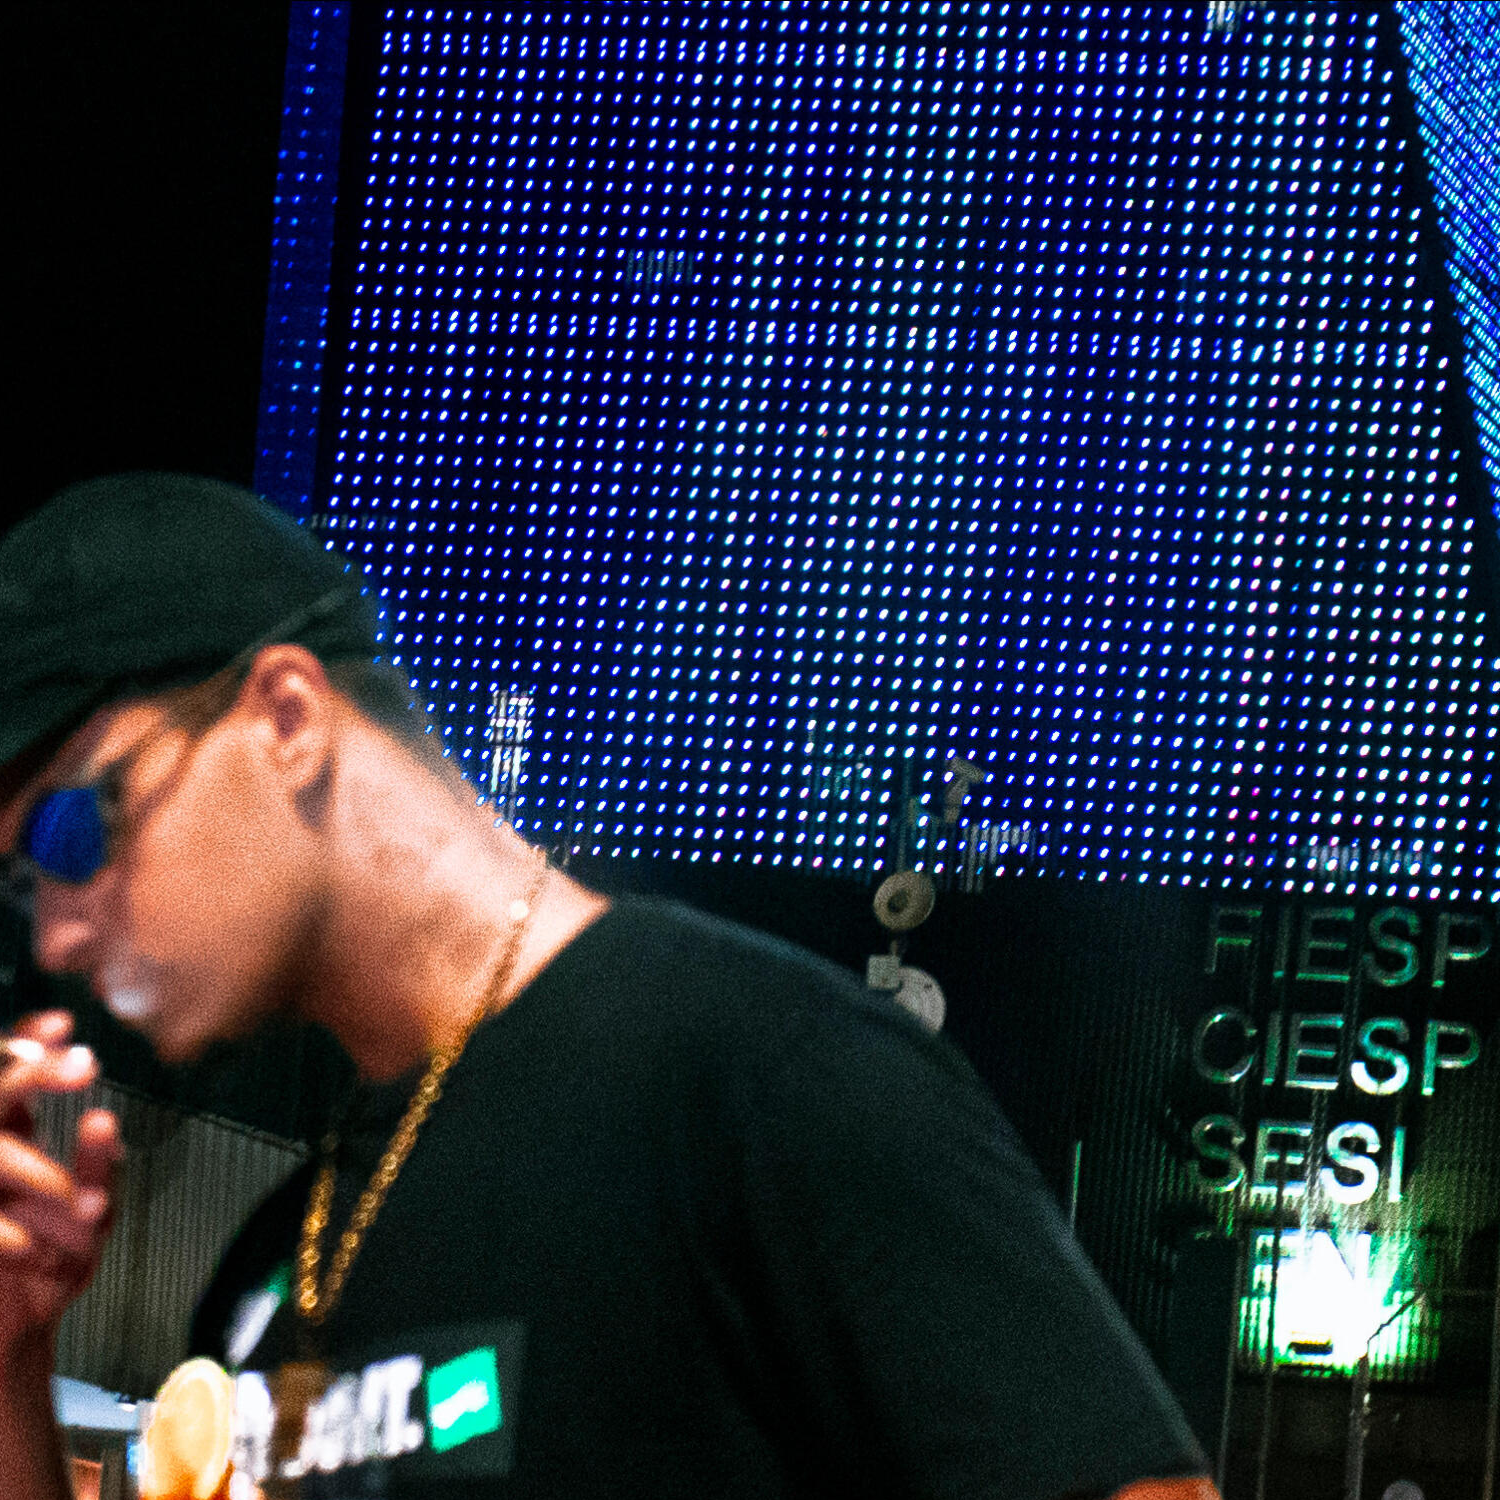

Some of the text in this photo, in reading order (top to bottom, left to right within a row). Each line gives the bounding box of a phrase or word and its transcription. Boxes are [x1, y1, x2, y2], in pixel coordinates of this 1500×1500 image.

[1205, 904, 1491, 988] FIESP
[1194, 1005, 1480, 1097] CIESP
[1190, 1113, 1407, 1205] SESI
